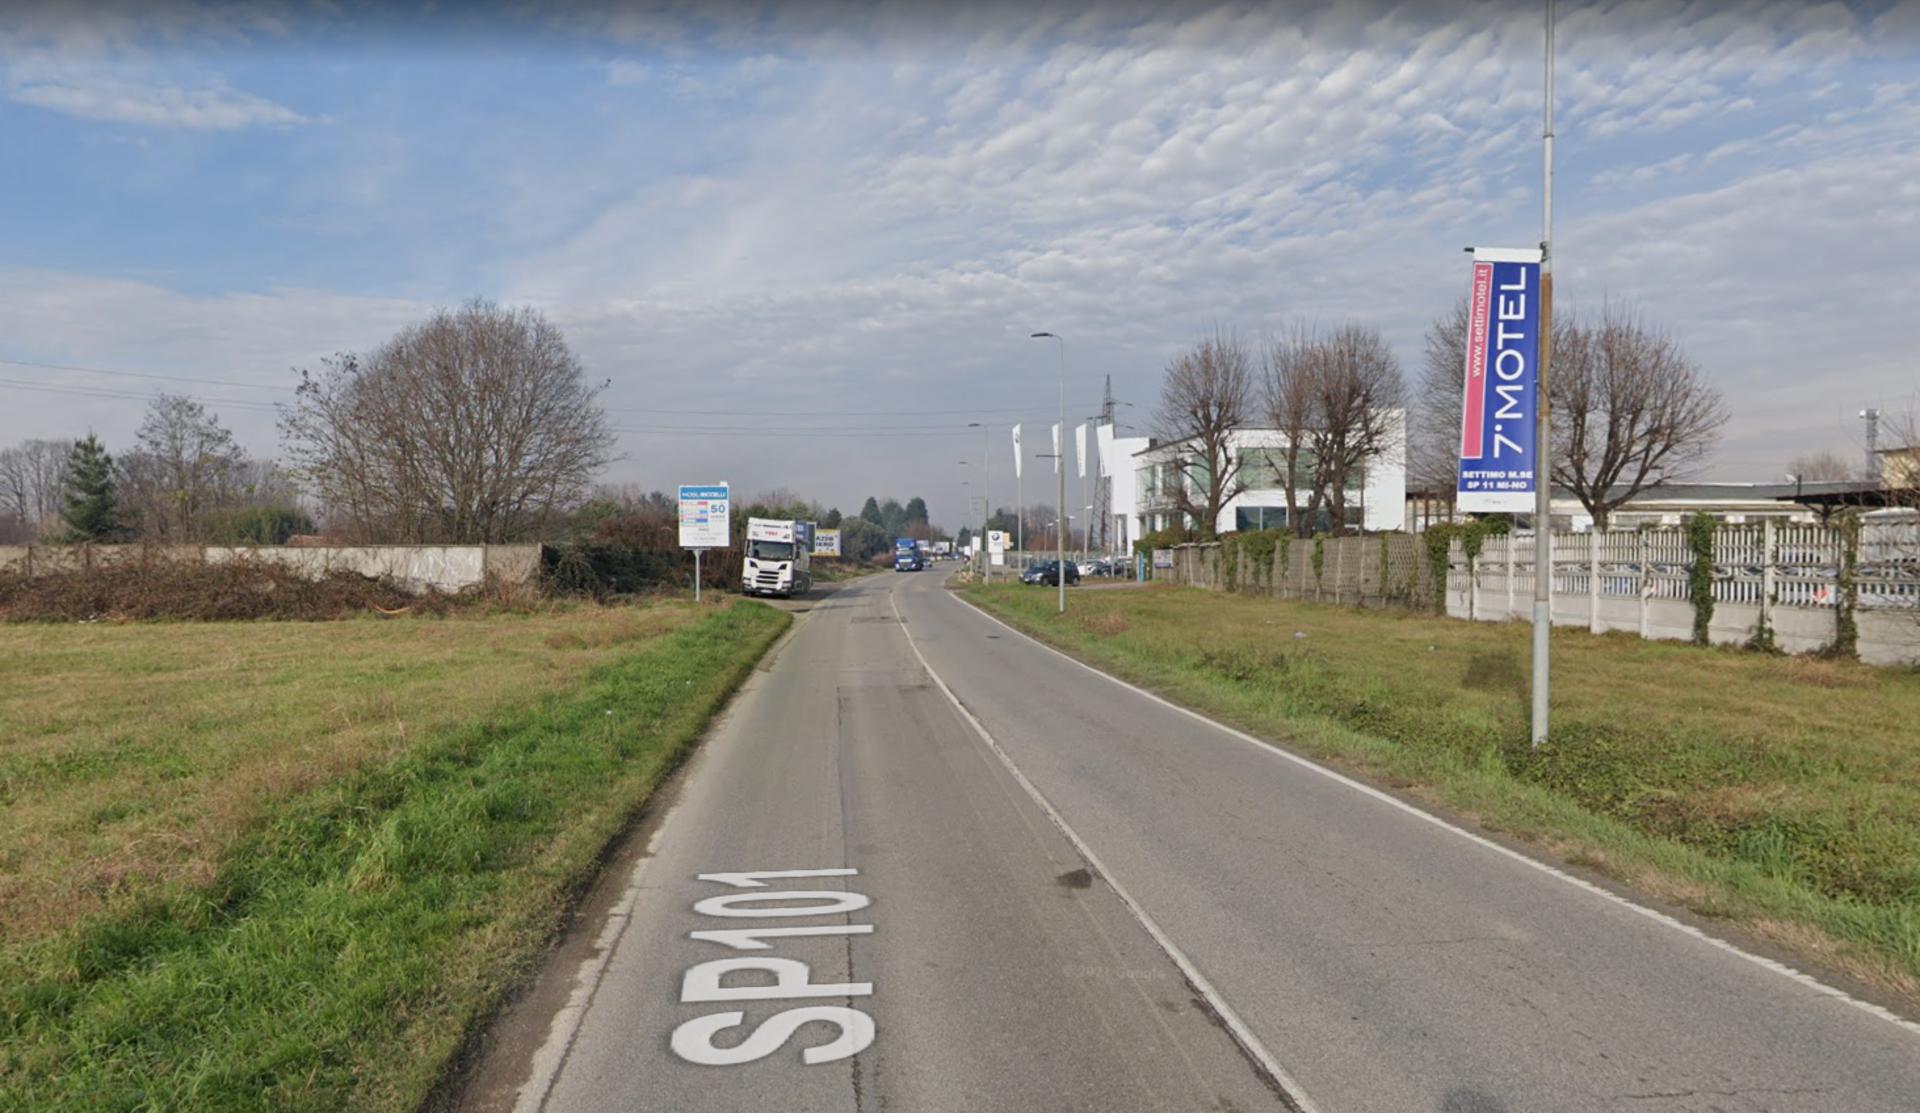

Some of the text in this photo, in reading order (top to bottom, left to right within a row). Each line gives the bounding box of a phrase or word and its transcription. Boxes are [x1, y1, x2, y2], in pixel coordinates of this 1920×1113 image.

[1472, 268, 1489, 378] www.settimotel.it
[1462, 470, 1534, 479] SETTIMO M.SE
[1467, 481, 1527, 489] SP 11 MI-NO
[710, 504, 726, 513] 50
